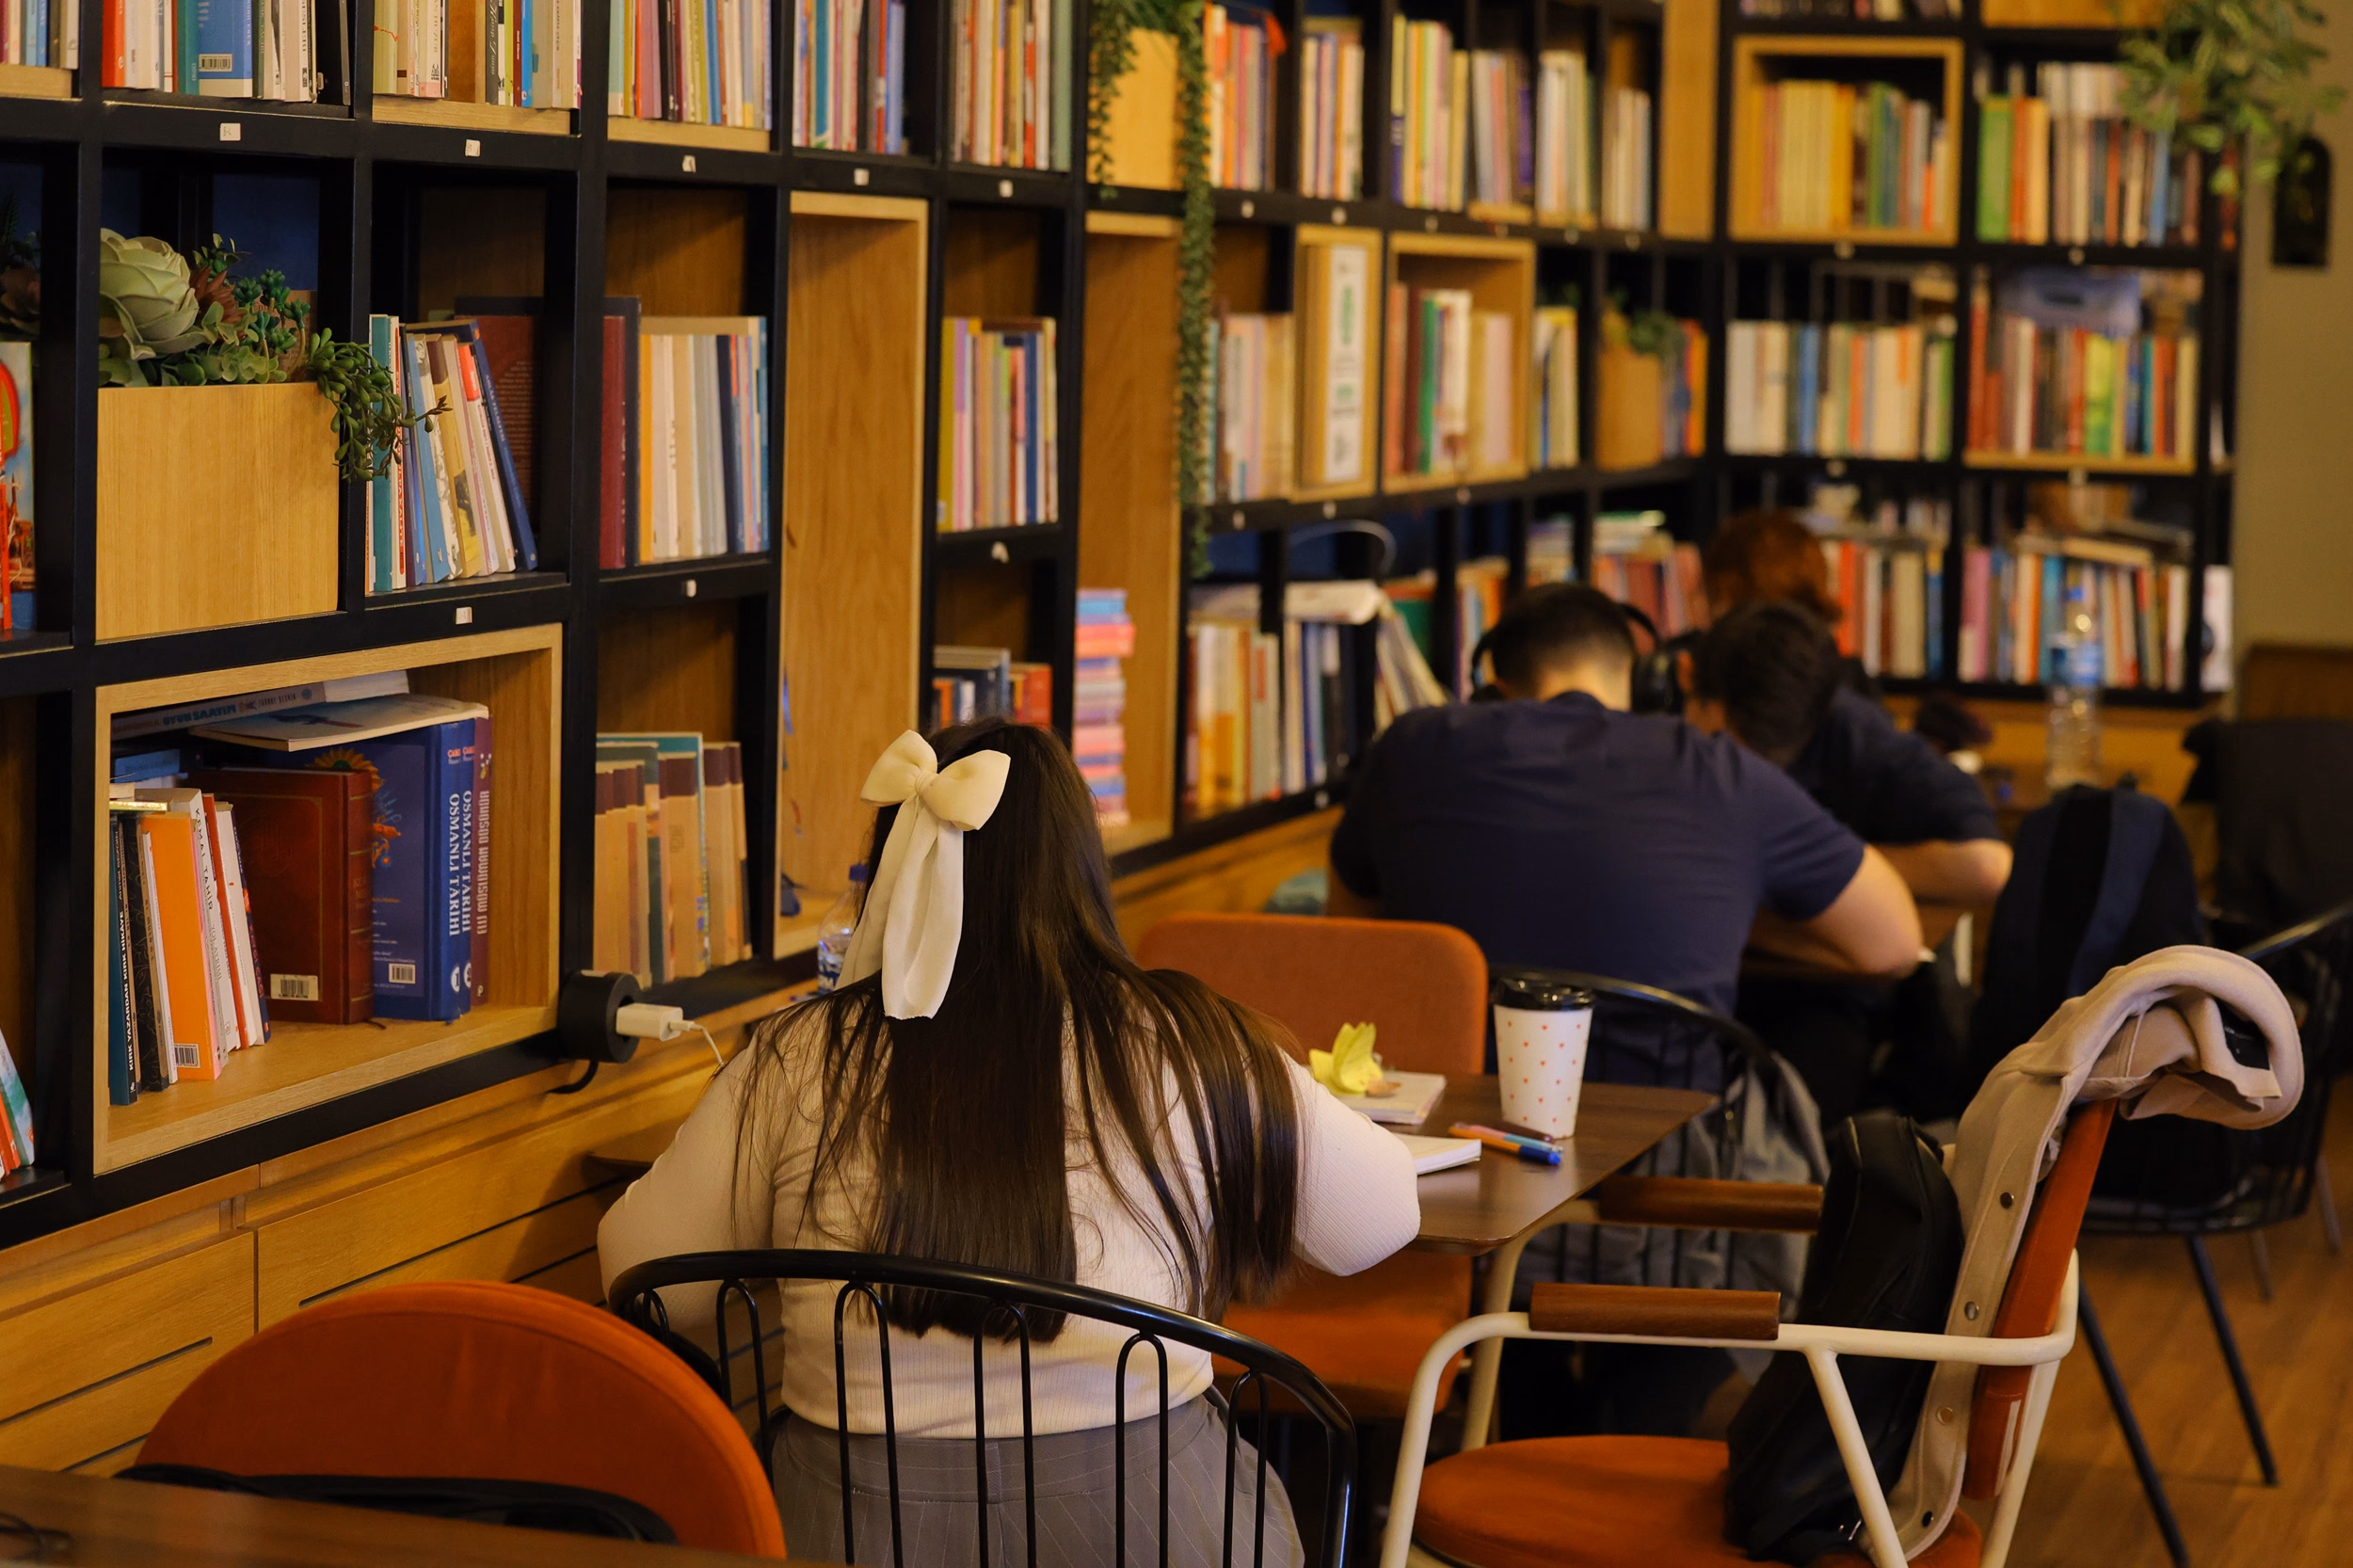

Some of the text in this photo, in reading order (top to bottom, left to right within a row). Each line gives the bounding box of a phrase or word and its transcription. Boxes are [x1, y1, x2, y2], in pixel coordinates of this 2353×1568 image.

[449, 793, 460, 872] OSMANLI
[462, 790, 472, 868] OSMANLI
[124, 983, 132, 1043] YAZARDAN
